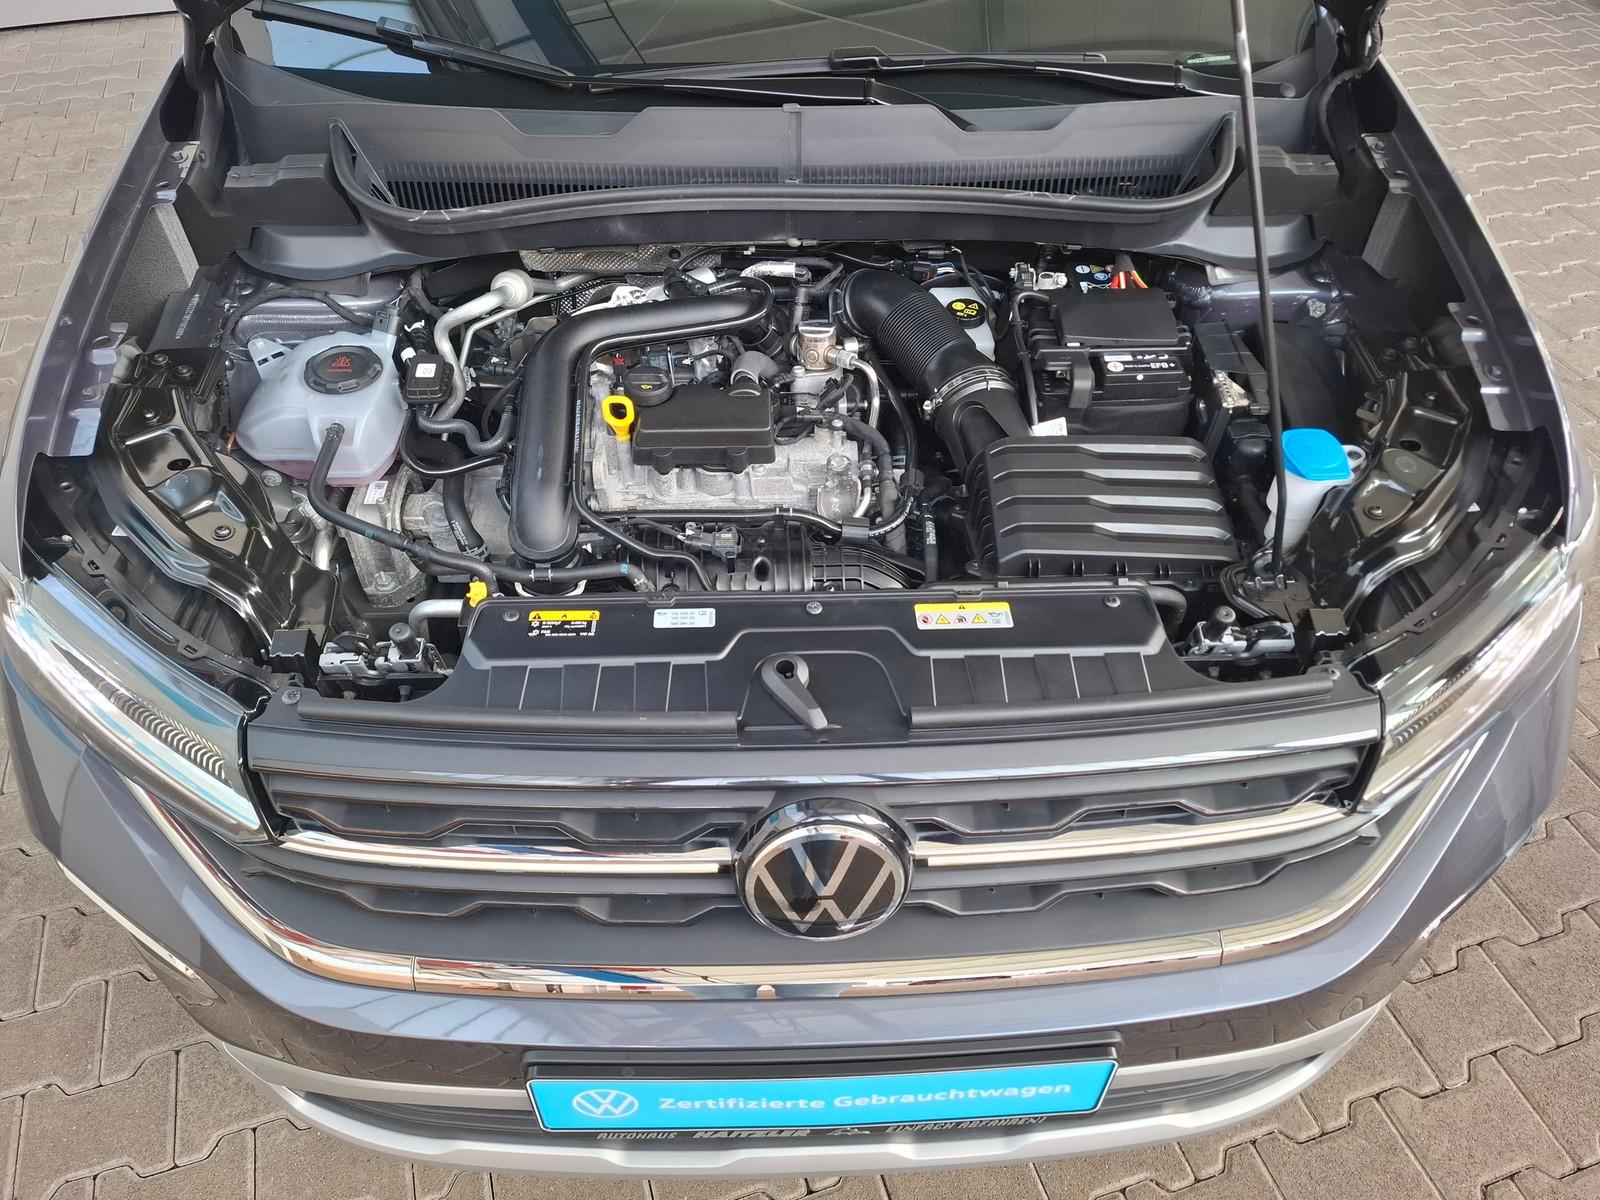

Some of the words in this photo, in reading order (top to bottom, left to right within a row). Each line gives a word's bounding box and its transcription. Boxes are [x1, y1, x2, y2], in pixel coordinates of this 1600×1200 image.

[749, 831, 902, 938] VW
[572, 1088, 640, 1119] VW
[658, 1097, 825, 1111] Zertifizierte
[833, 1083, 1072, 1108] Gebrauchtwagen
[596, 1131, 678, 1140] AUTOHAUS
